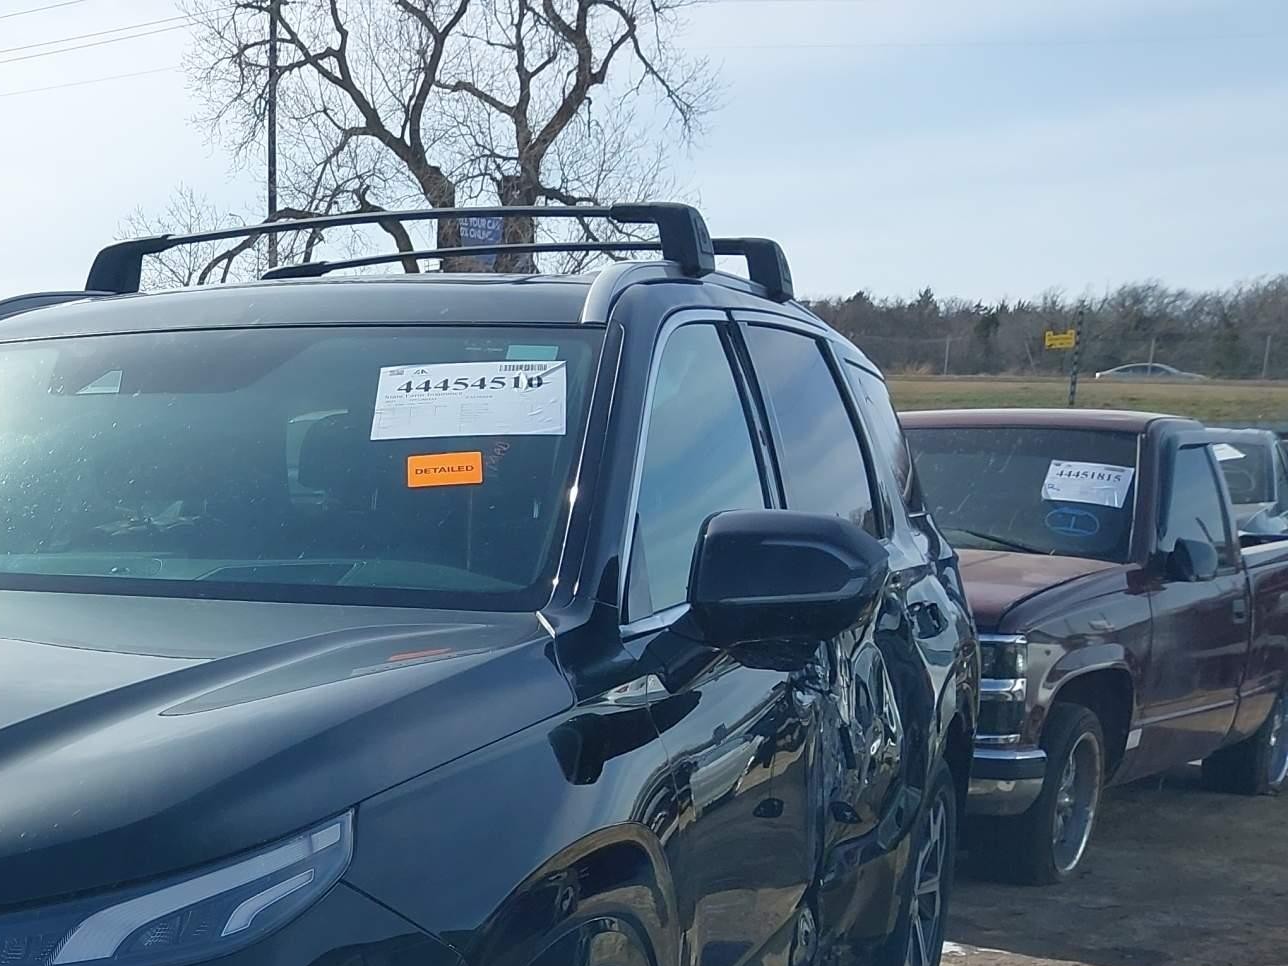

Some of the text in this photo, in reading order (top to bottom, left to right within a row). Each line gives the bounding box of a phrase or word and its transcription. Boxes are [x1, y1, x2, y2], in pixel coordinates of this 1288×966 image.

[396, 376, 543, 393] 44454510
[415, 464, 474, 475] DETAILED
[1056, 470, 1123, 482] 44451815
